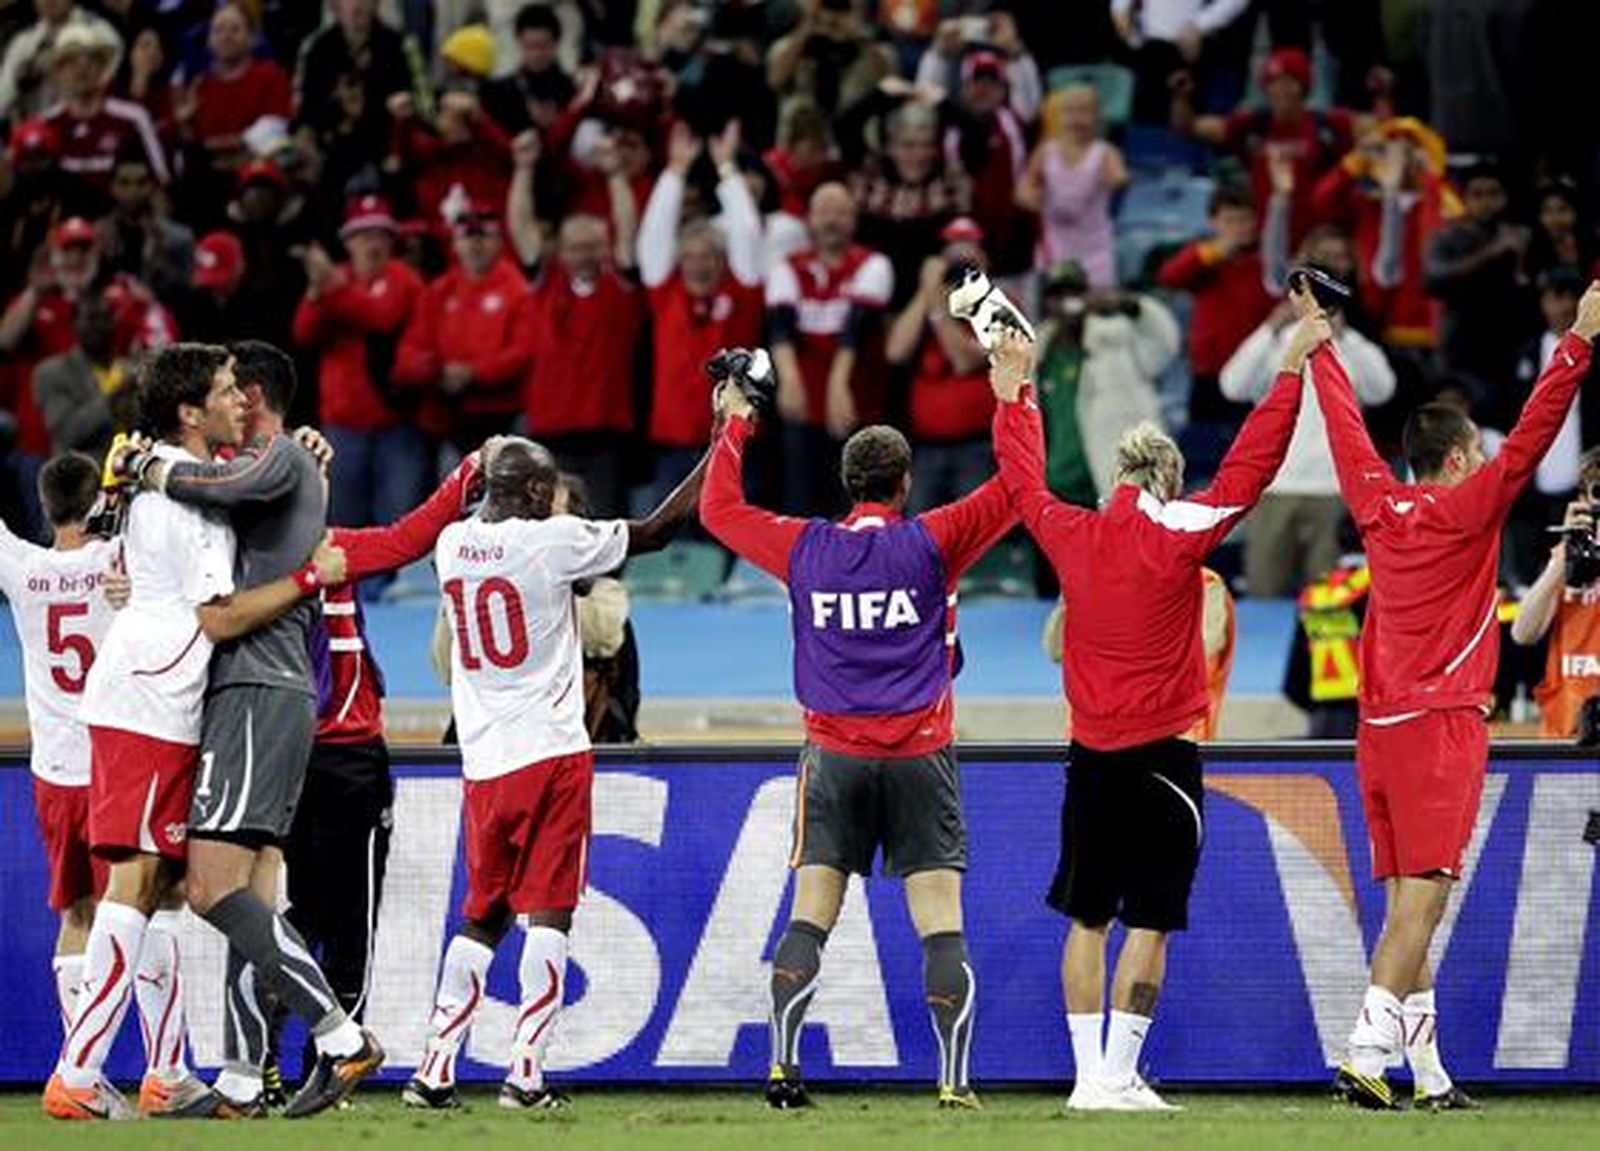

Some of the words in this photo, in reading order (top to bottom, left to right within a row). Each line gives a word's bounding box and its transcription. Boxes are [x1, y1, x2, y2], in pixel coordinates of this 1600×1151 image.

[47, 602, 96, 694] 5
[443, 576, 529, 671] 10
[810, 589, 921, 629] FIFA
[197, 752, 215, 797] 1
[190, 772, 900, 1069] ISA
